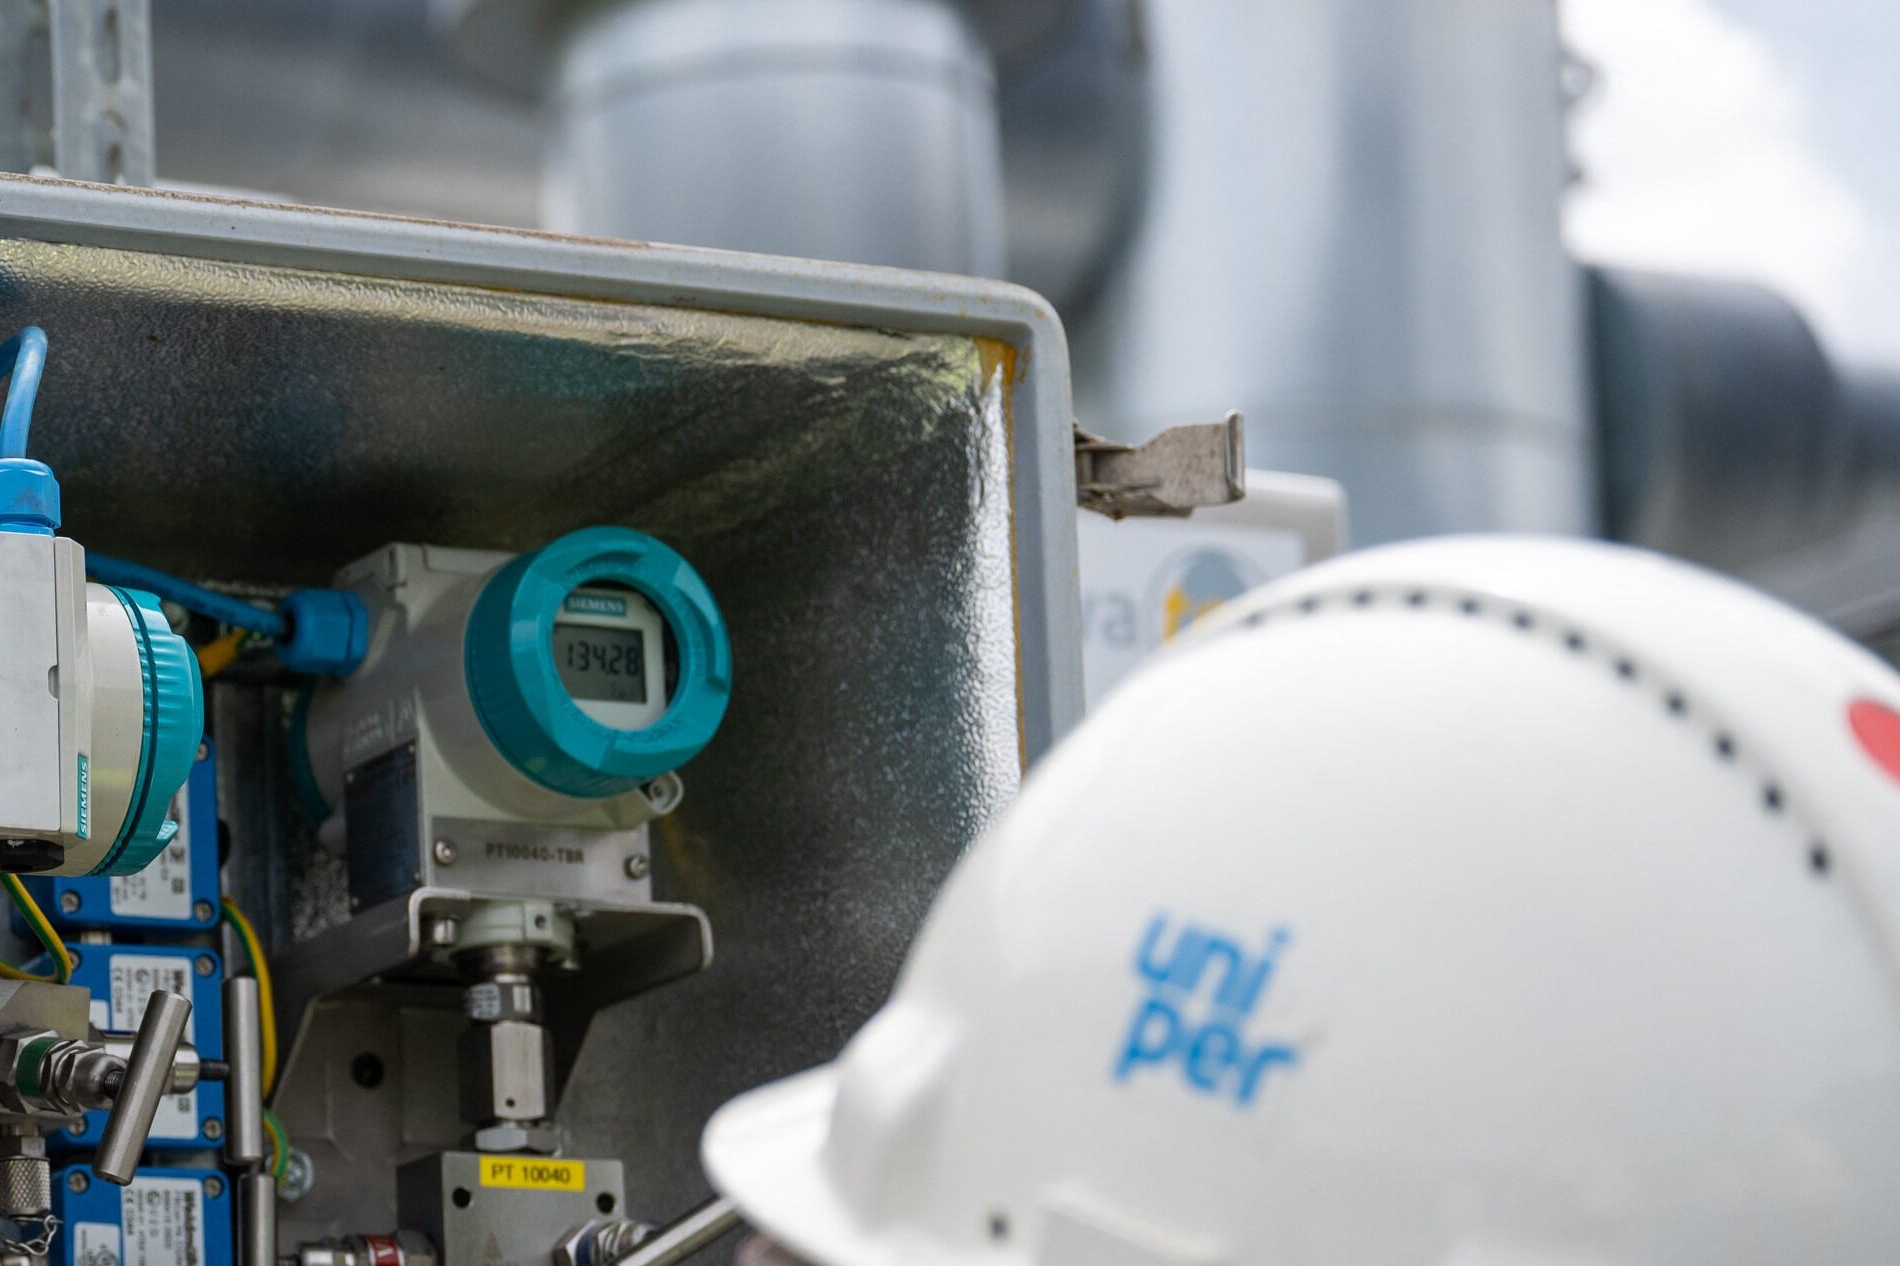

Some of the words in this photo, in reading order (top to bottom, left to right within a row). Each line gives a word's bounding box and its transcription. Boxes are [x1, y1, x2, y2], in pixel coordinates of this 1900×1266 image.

[567, 597, 625, 613] SIEMENS
[491, 1164, 515, 1180] PT
[522, 1165, 570, 1183] 10040
